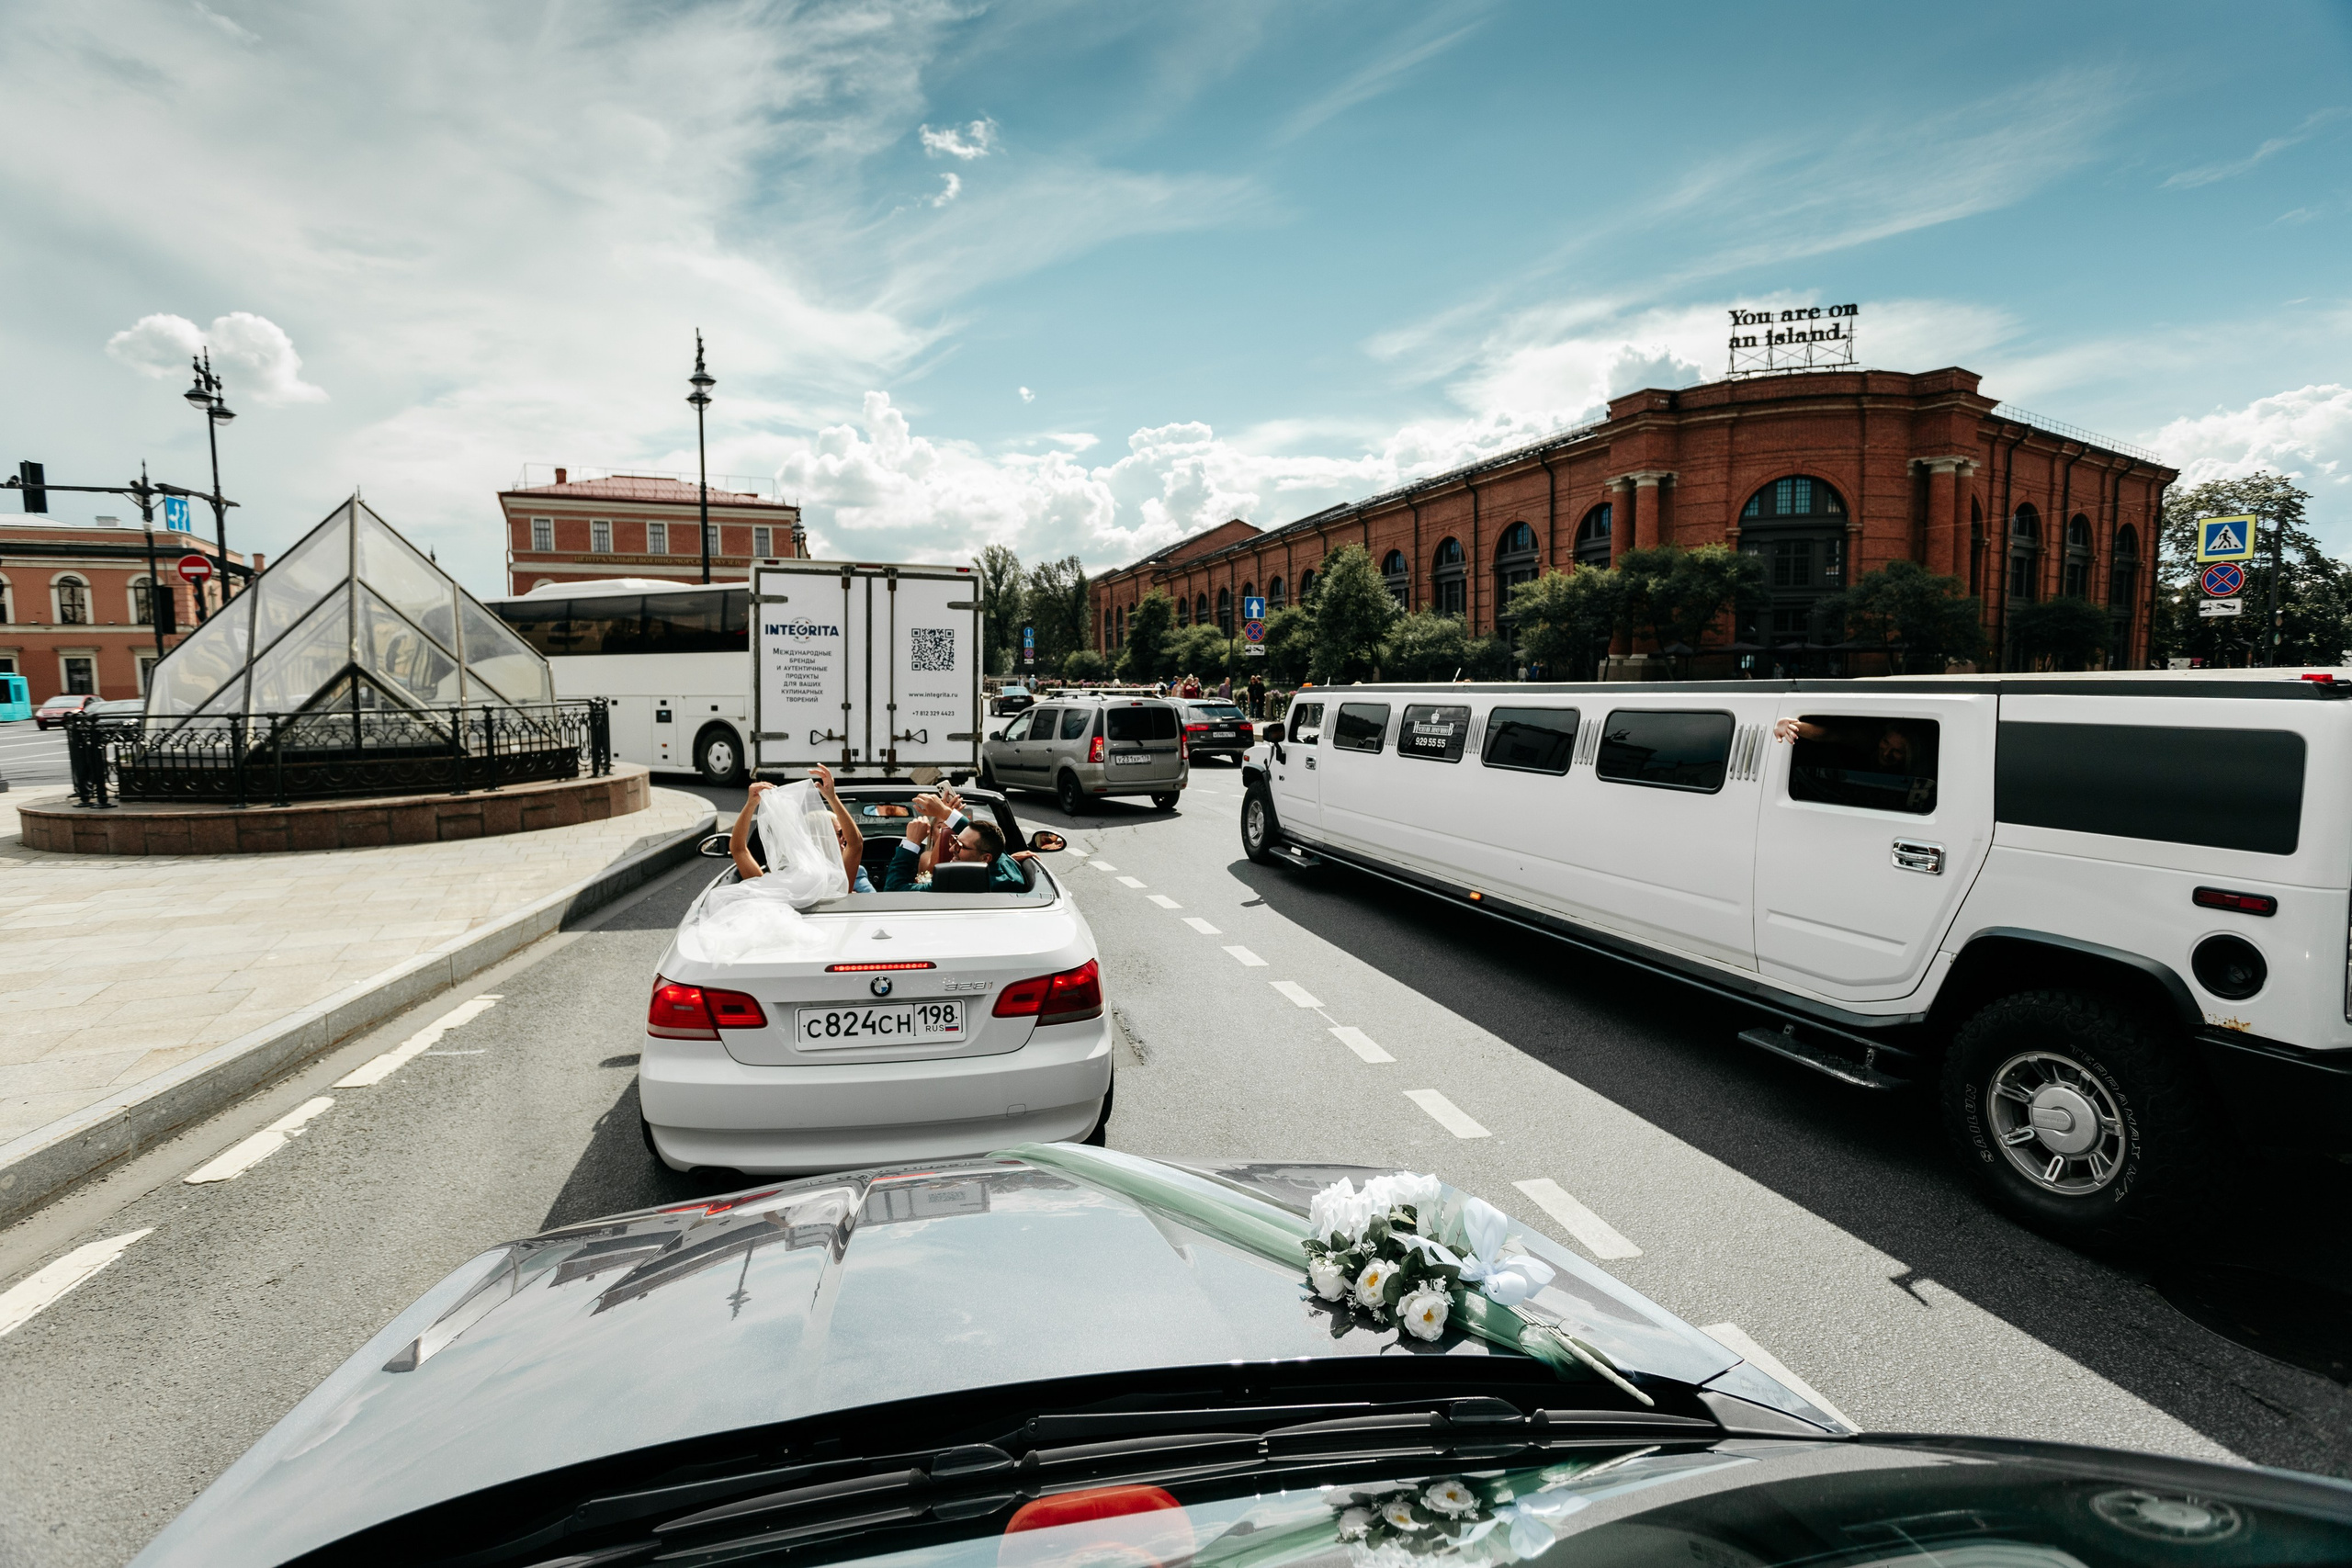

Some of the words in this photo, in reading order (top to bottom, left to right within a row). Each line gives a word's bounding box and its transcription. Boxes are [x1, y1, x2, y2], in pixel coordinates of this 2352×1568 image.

[1728, 309, 1772, 326] You
[1781, 306, 1820, 321] are
[1828, 302, 1859, 317] on
[1728, 334, 1757, 348] an
[1766, 322, 1848, 346] island.
[764, 624, 839, 637] INTEGRITA
[773, 648, 831, 657] МЕЖДУНАРОДНЫЕ
[1415, 737, 1428, 746] 929
[1428, 738, 1437, 748] 55
[1437, 739, 1446, 748] 55
[944, 981, 993, 992] 328i
[917, 1004, 955, 1025] 198
[925, 1024, 944, 1032] RUS
[1964, 1083, 1995, 1164] SAILUN
[2069, 1043, 2142, 1160] TERRAMAX
[2114, 1163, 2138, 1202] M/T
